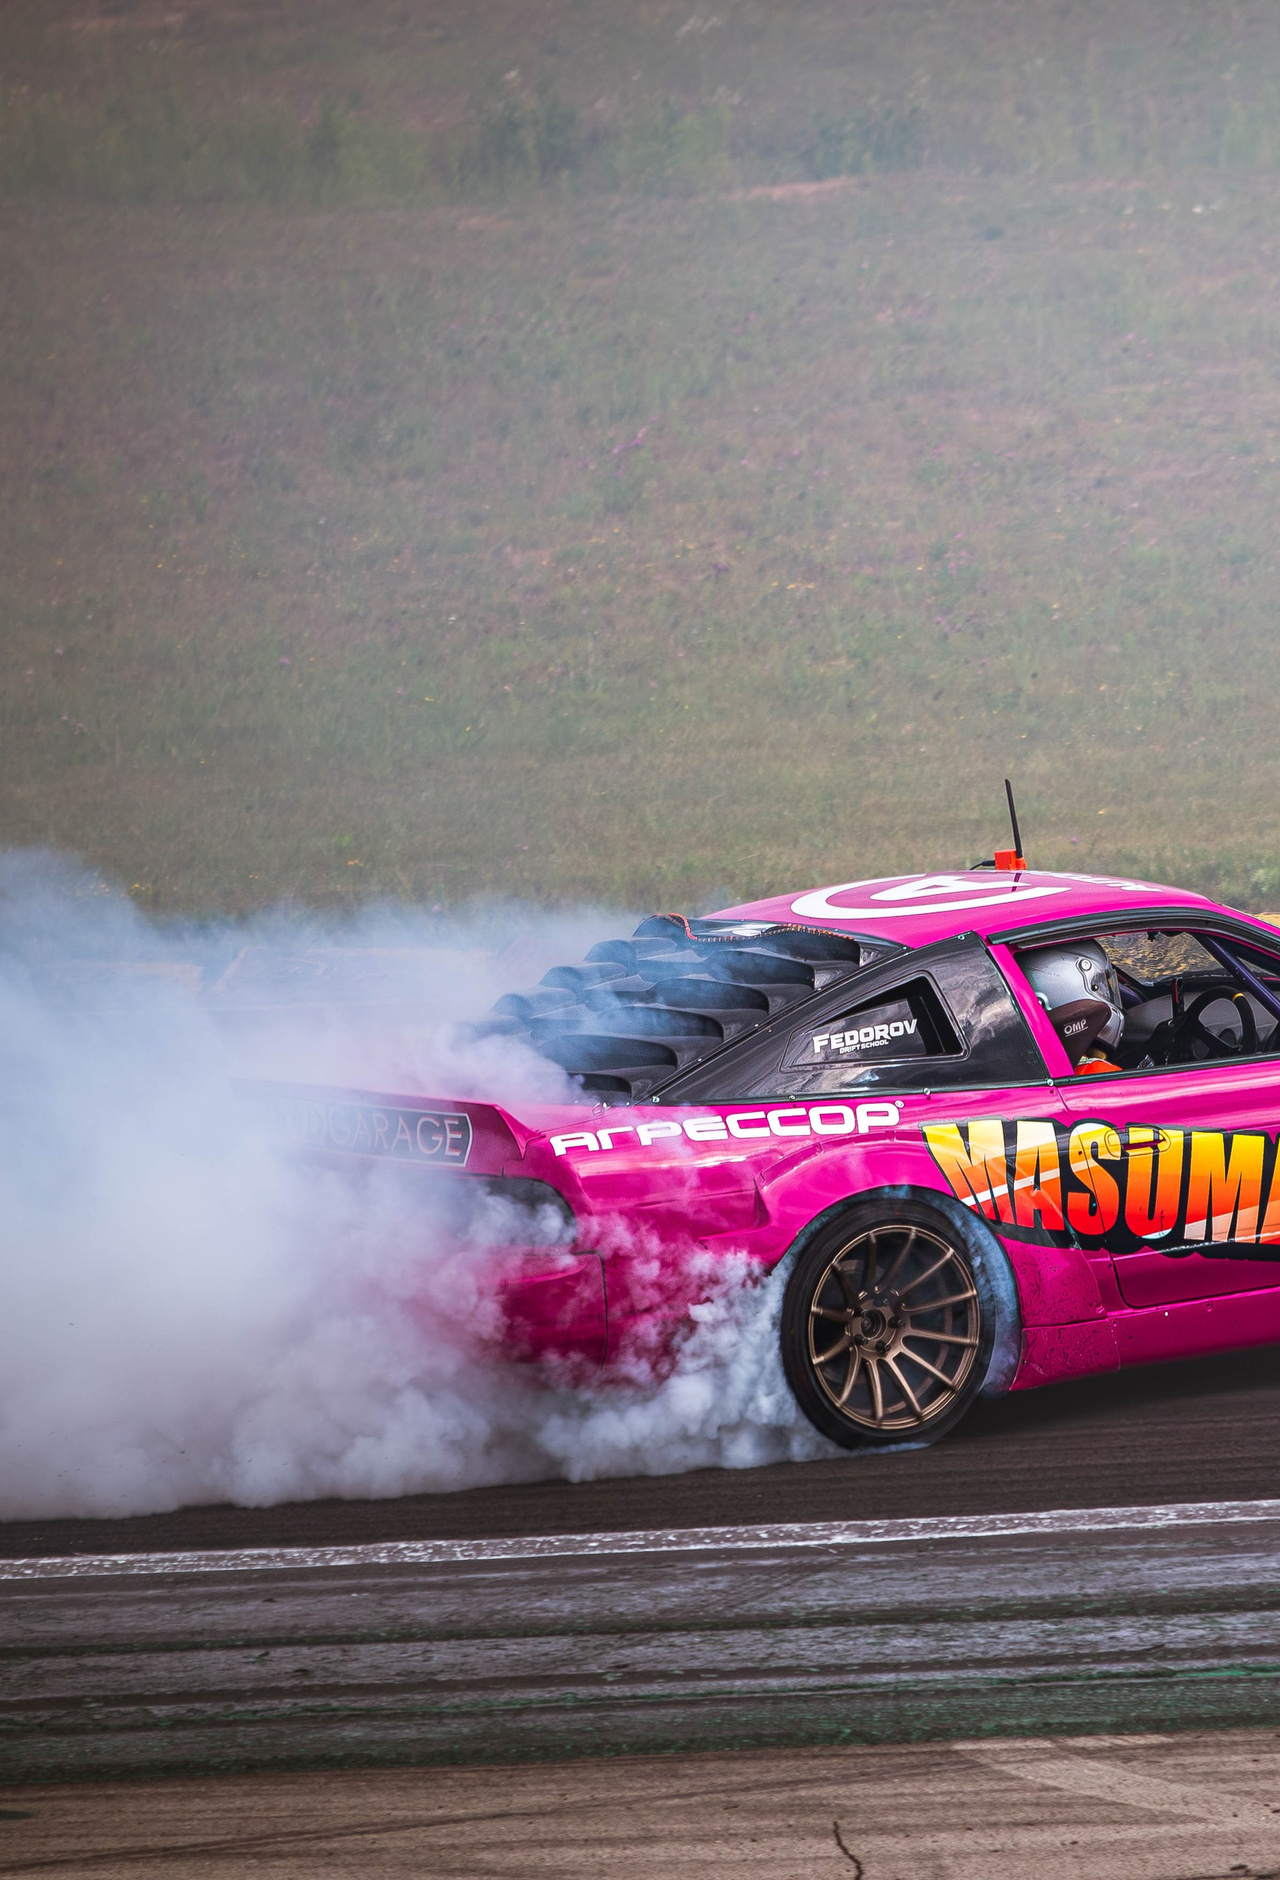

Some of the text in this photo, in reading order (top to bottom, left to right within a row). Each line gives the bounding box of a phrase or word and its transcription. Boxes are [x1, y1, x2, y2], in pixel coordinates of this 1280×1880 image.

[812, 1019, 918, 1054] FEDOROV
[1063, 1019, 1087, 1035] OMP
[839, 1039, 889, 1054] DRIFT SCHOOL
[328, 1107, 463, 1157] GARAGE
[549, 1102, 901, 1157] АГРЕССОР
